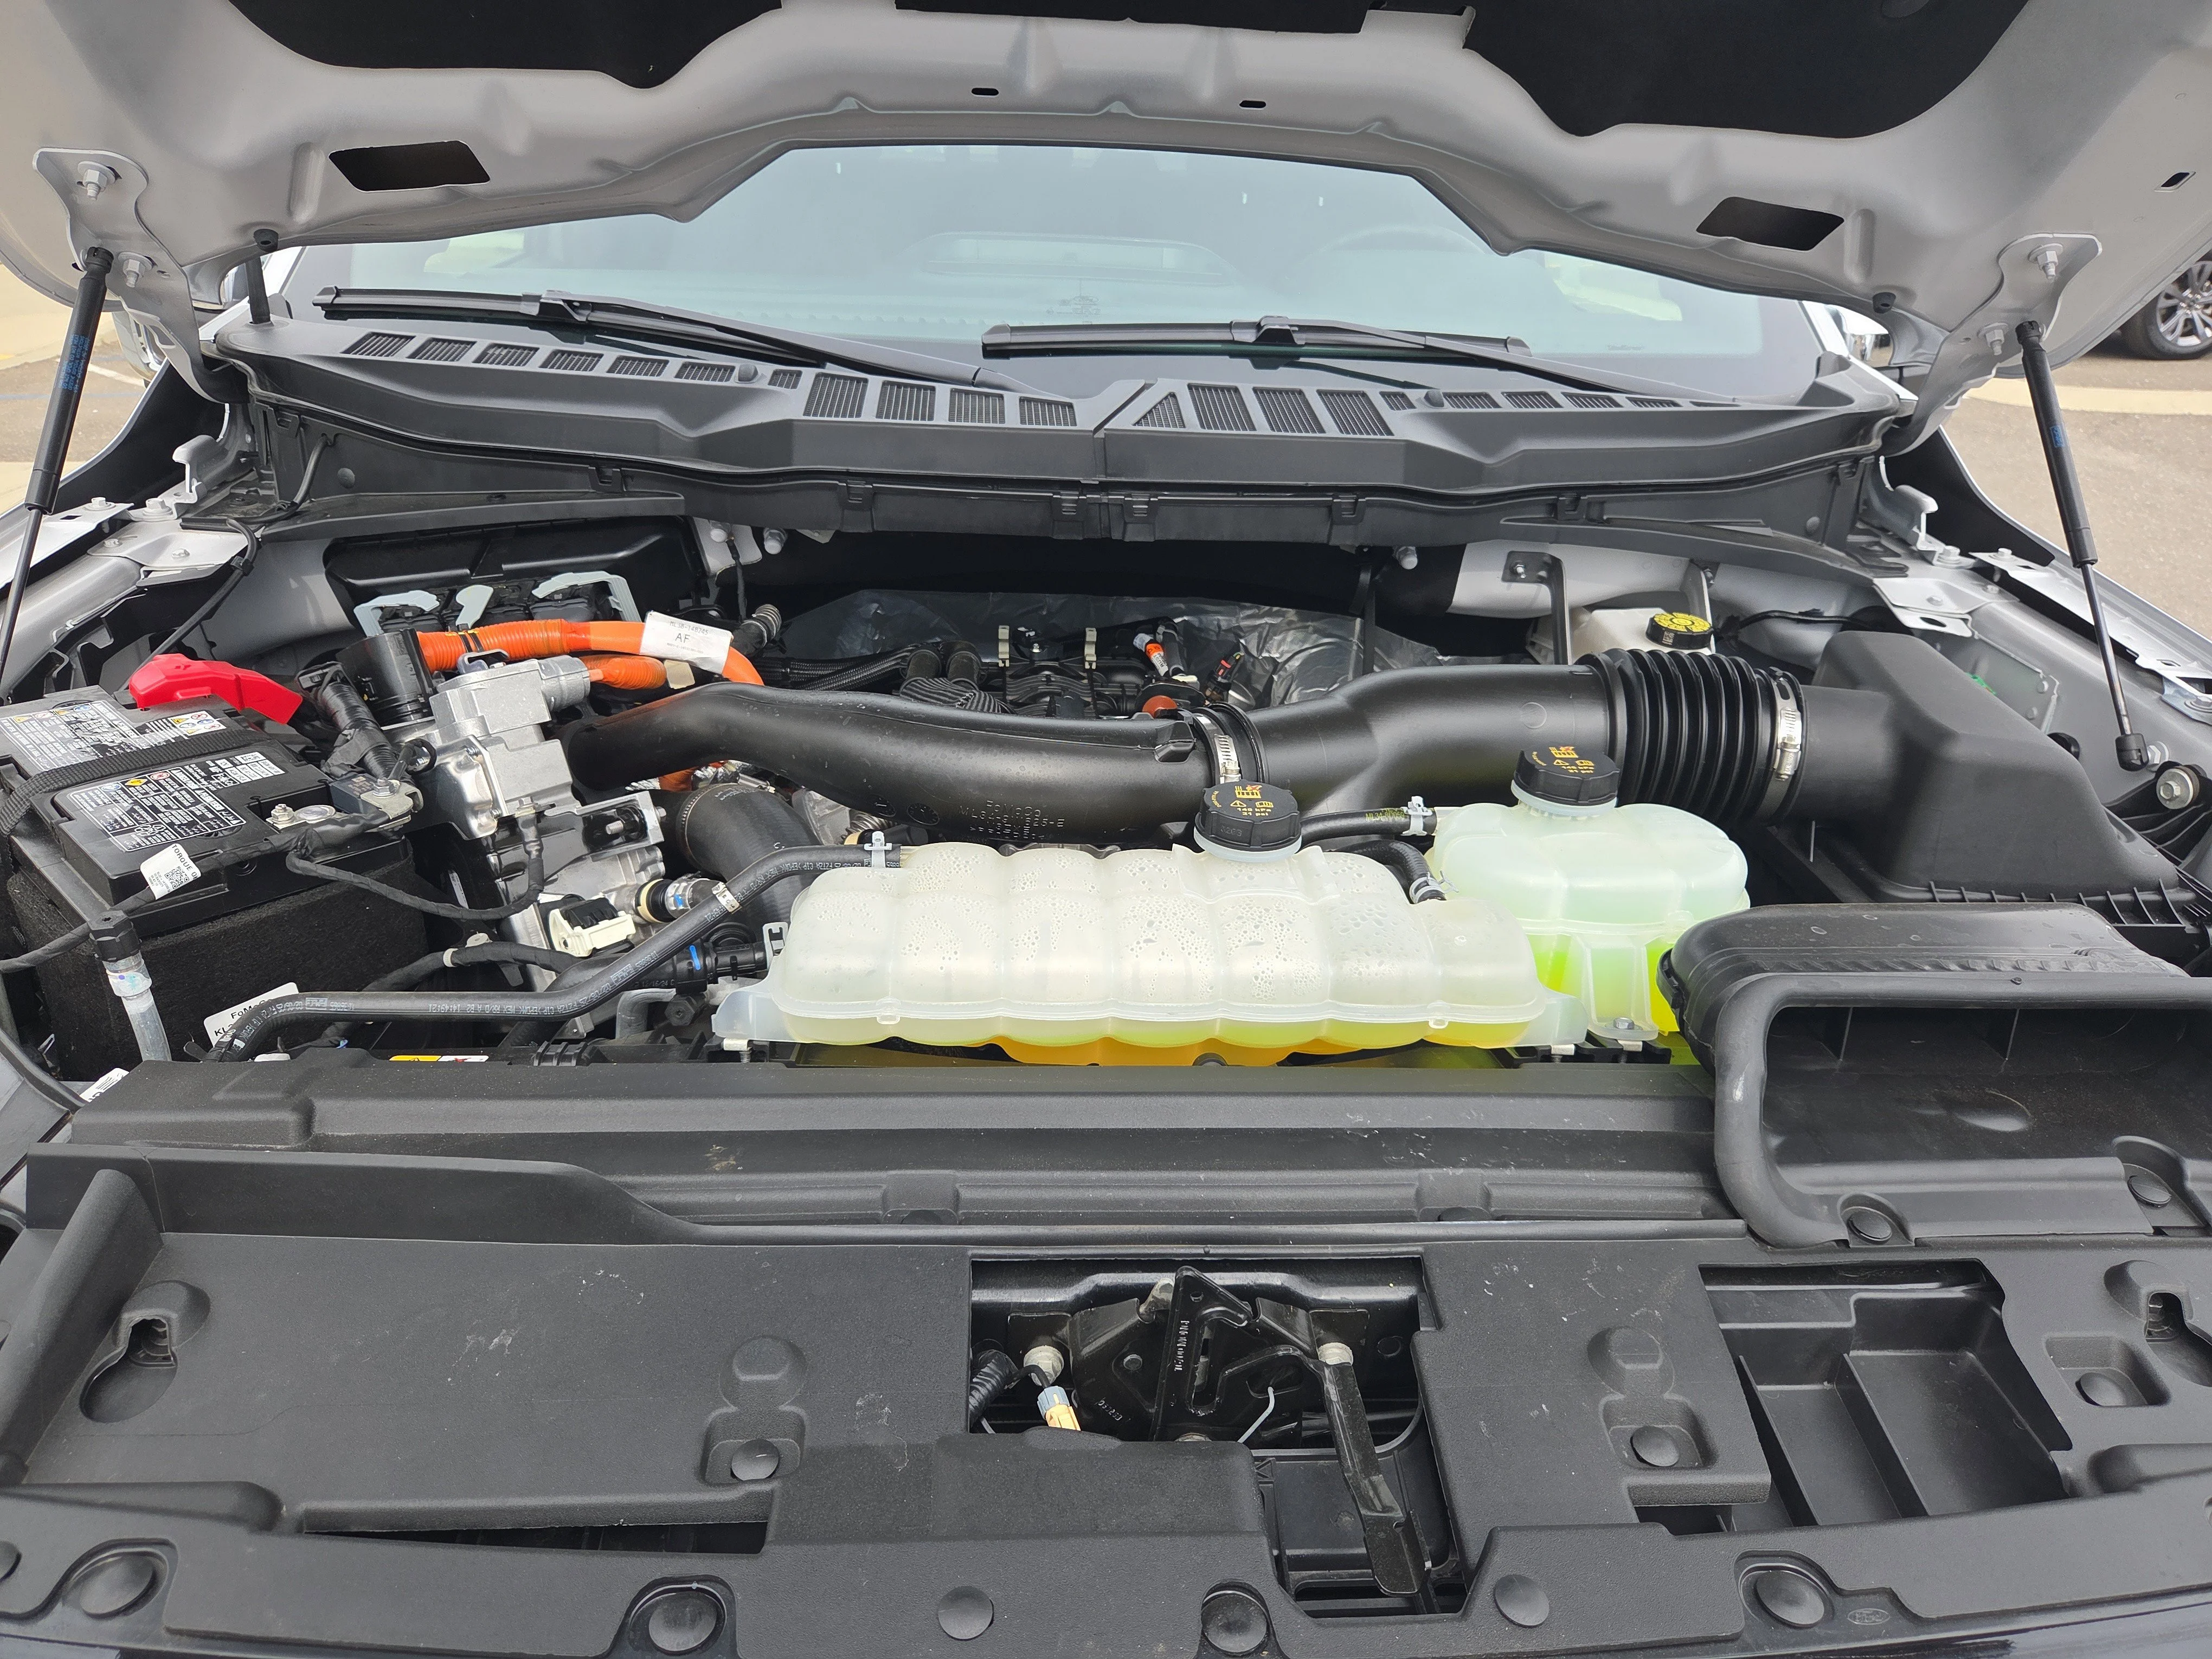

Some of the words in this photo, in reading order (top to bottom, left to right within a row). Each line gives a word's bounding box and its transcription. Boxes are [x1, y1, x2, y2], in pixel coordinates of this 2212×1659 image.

[675, 633, 690, 643] AF
[168, 844, 196, 872] TORQUE
[428, 1003, 461, 1012] 14:49:21
